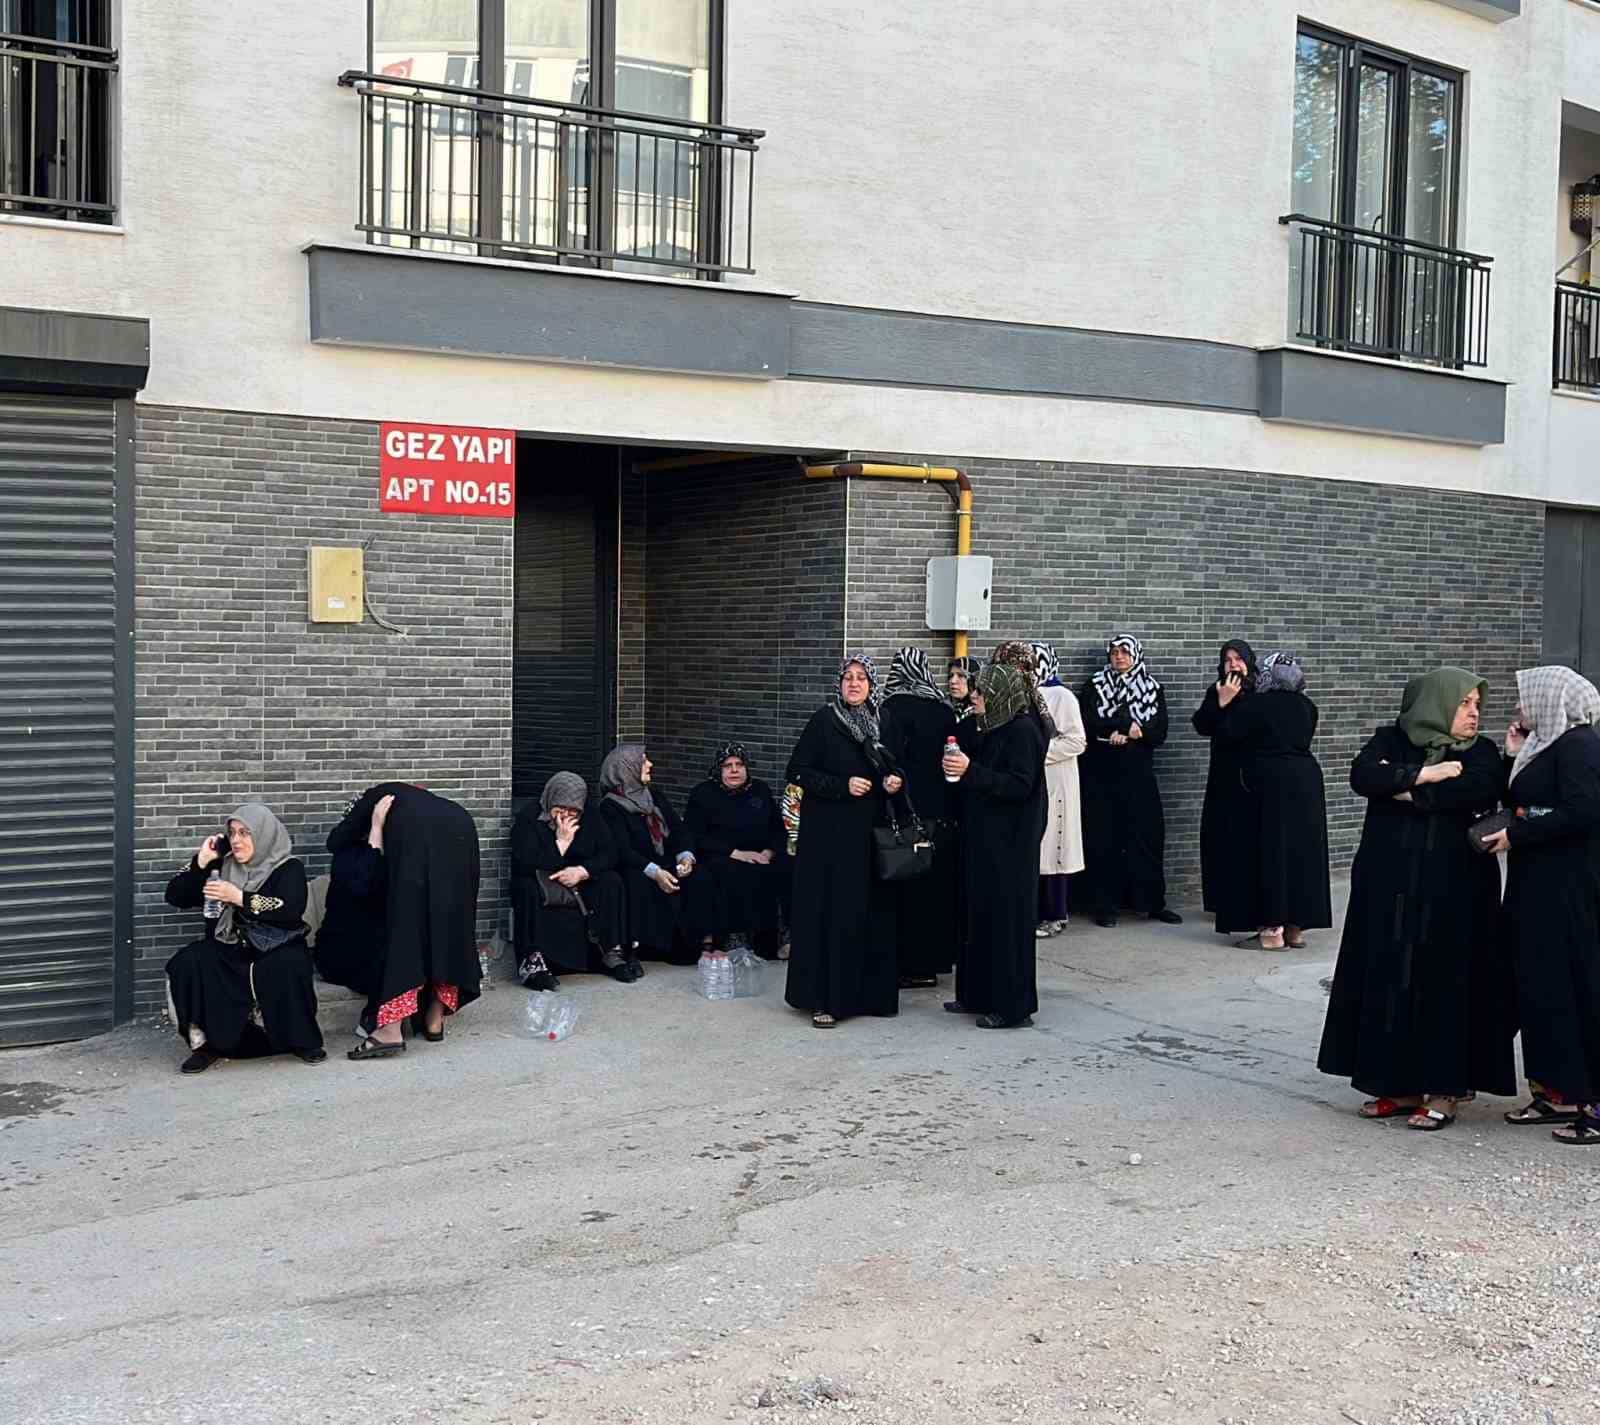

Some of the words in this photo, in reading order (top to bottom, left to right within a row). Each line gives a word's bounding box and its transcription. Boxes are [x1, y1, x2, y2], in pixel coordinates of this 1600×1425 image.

[385, 430, 446, 460] GEZ
[451, 434, 512, 465] YAPI
[385, 477, 435, 502] APT
